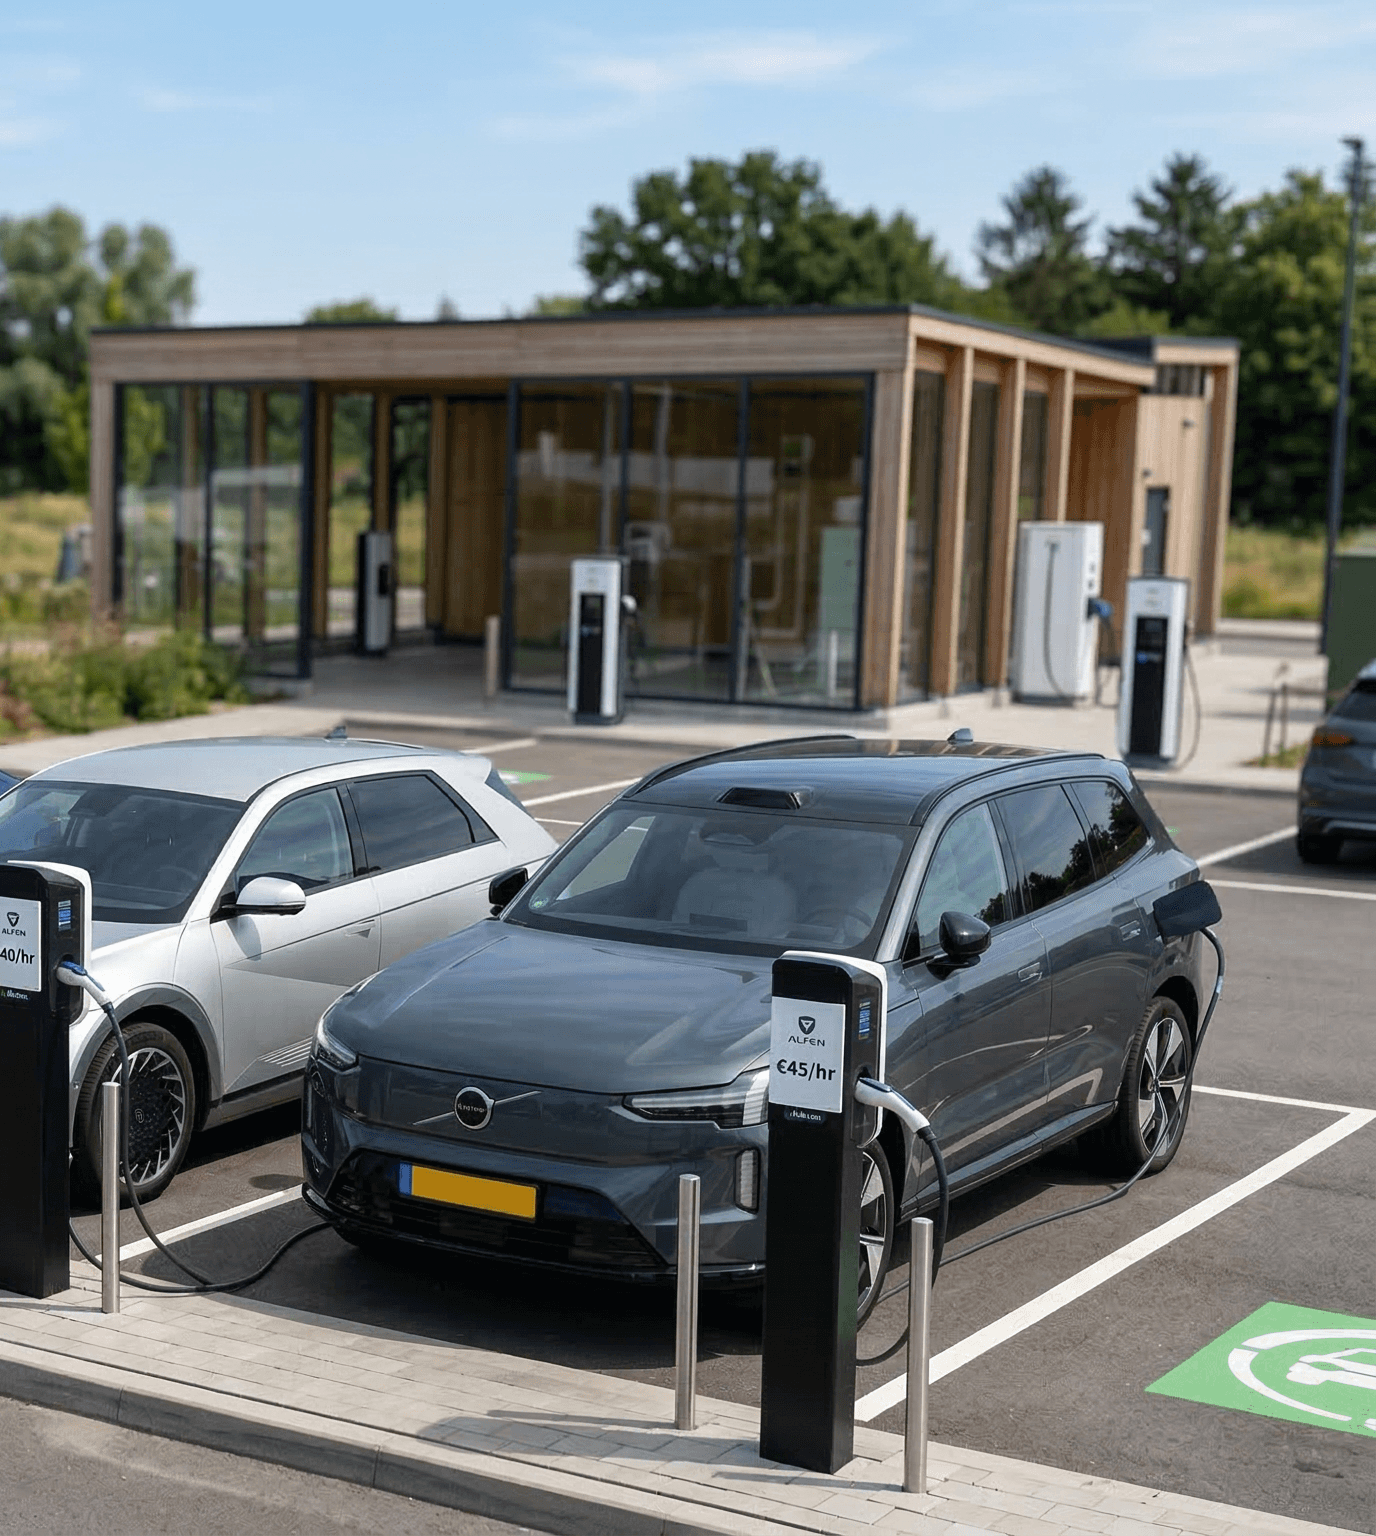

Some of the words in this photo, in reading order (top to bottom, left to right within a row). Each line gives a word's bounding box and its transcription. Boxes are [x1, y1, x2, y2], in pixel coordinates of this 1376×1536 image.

[2, 928, 26, 936] ALFEN
[788, 1035, 825, 1047] ALFEN
[777, 1059, 836, 1081] €45/hr
